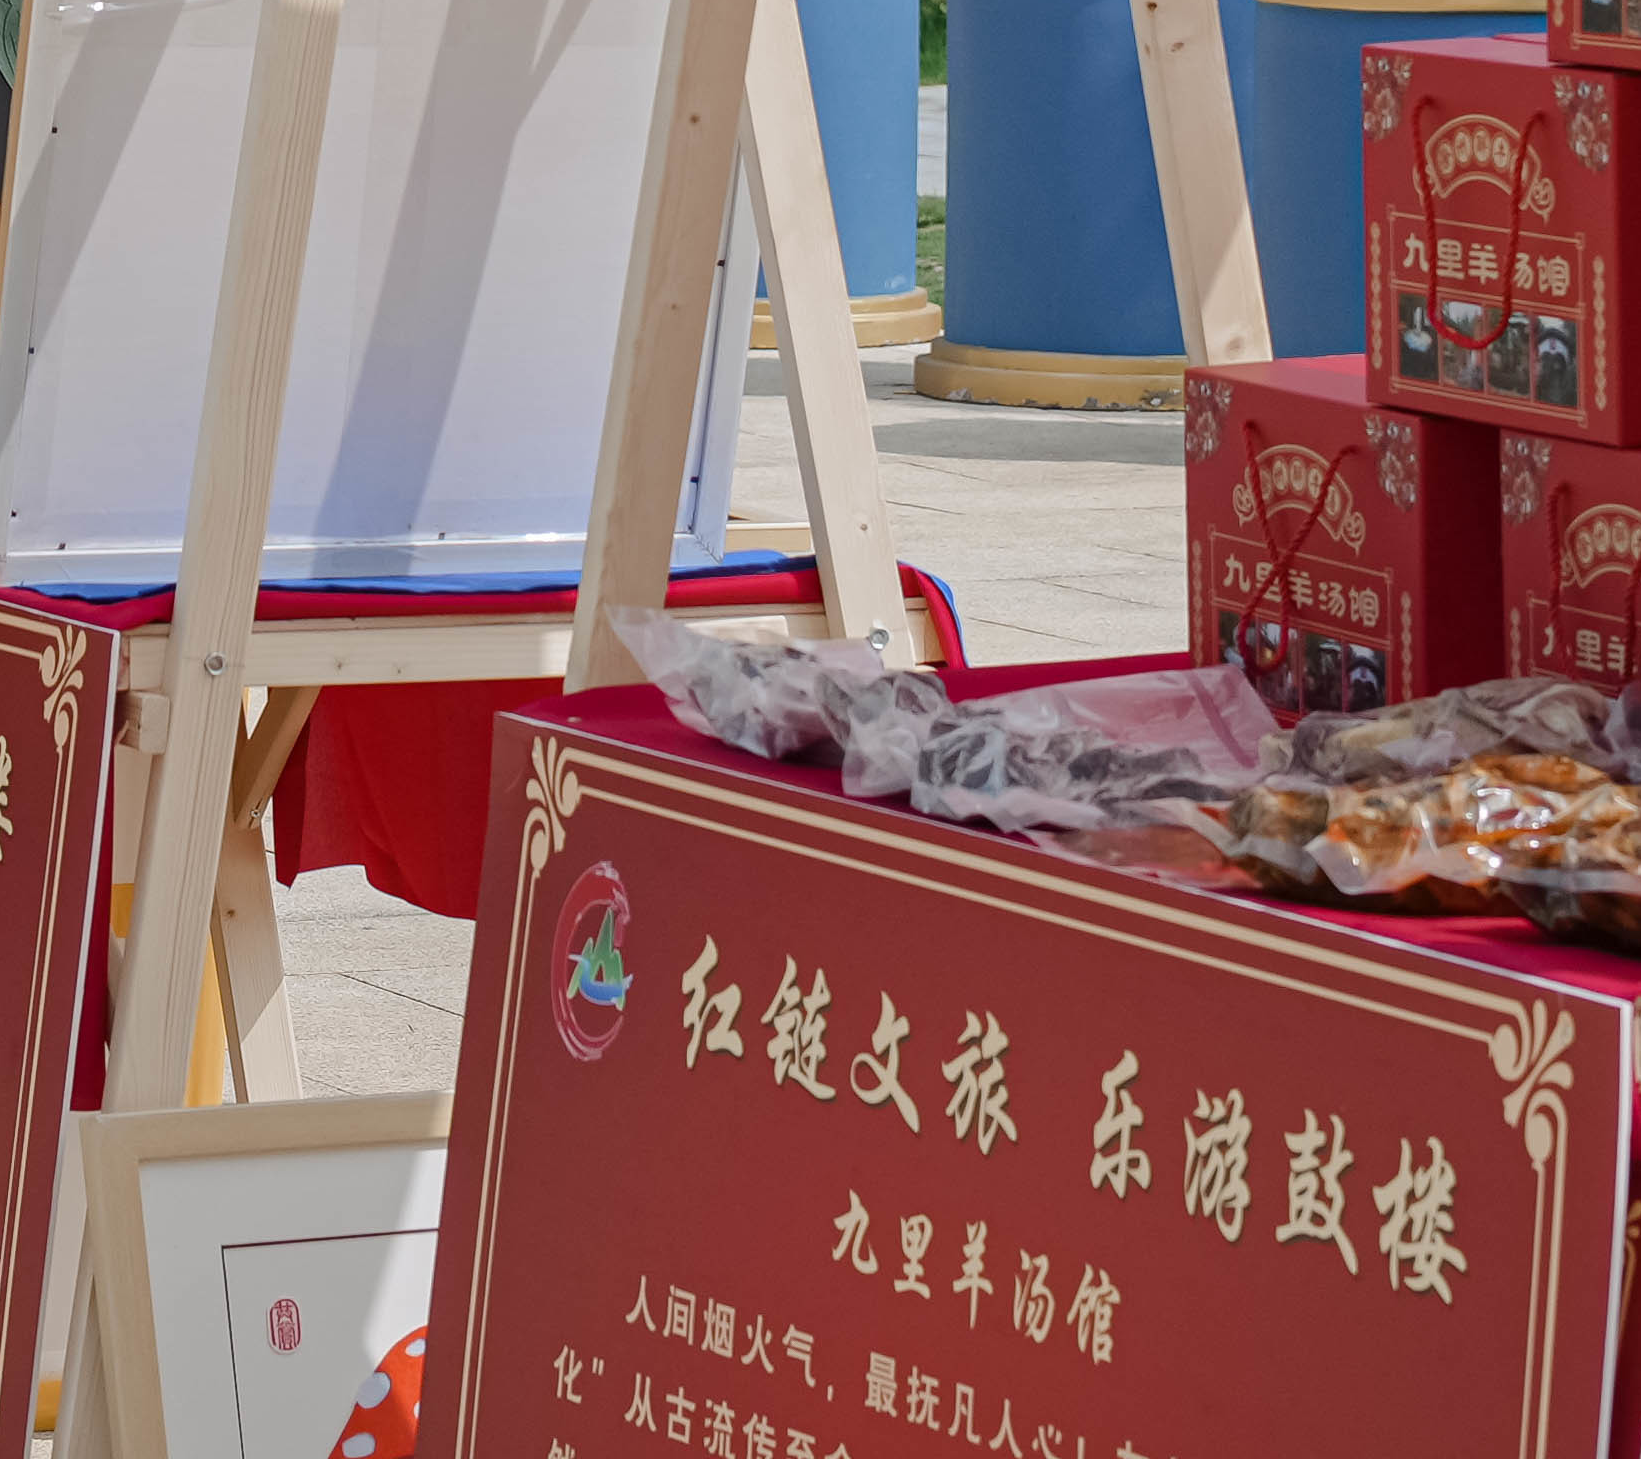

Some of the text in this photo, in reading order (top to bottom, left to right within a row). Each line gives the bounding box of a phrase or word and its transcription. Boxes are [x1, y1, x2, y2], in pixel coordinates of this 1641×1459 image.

[679, 934, 1470, 1305] 红链文旅 乐游鼓楼
[831, 1188, 1122, 1365] 九里羊汤馆
